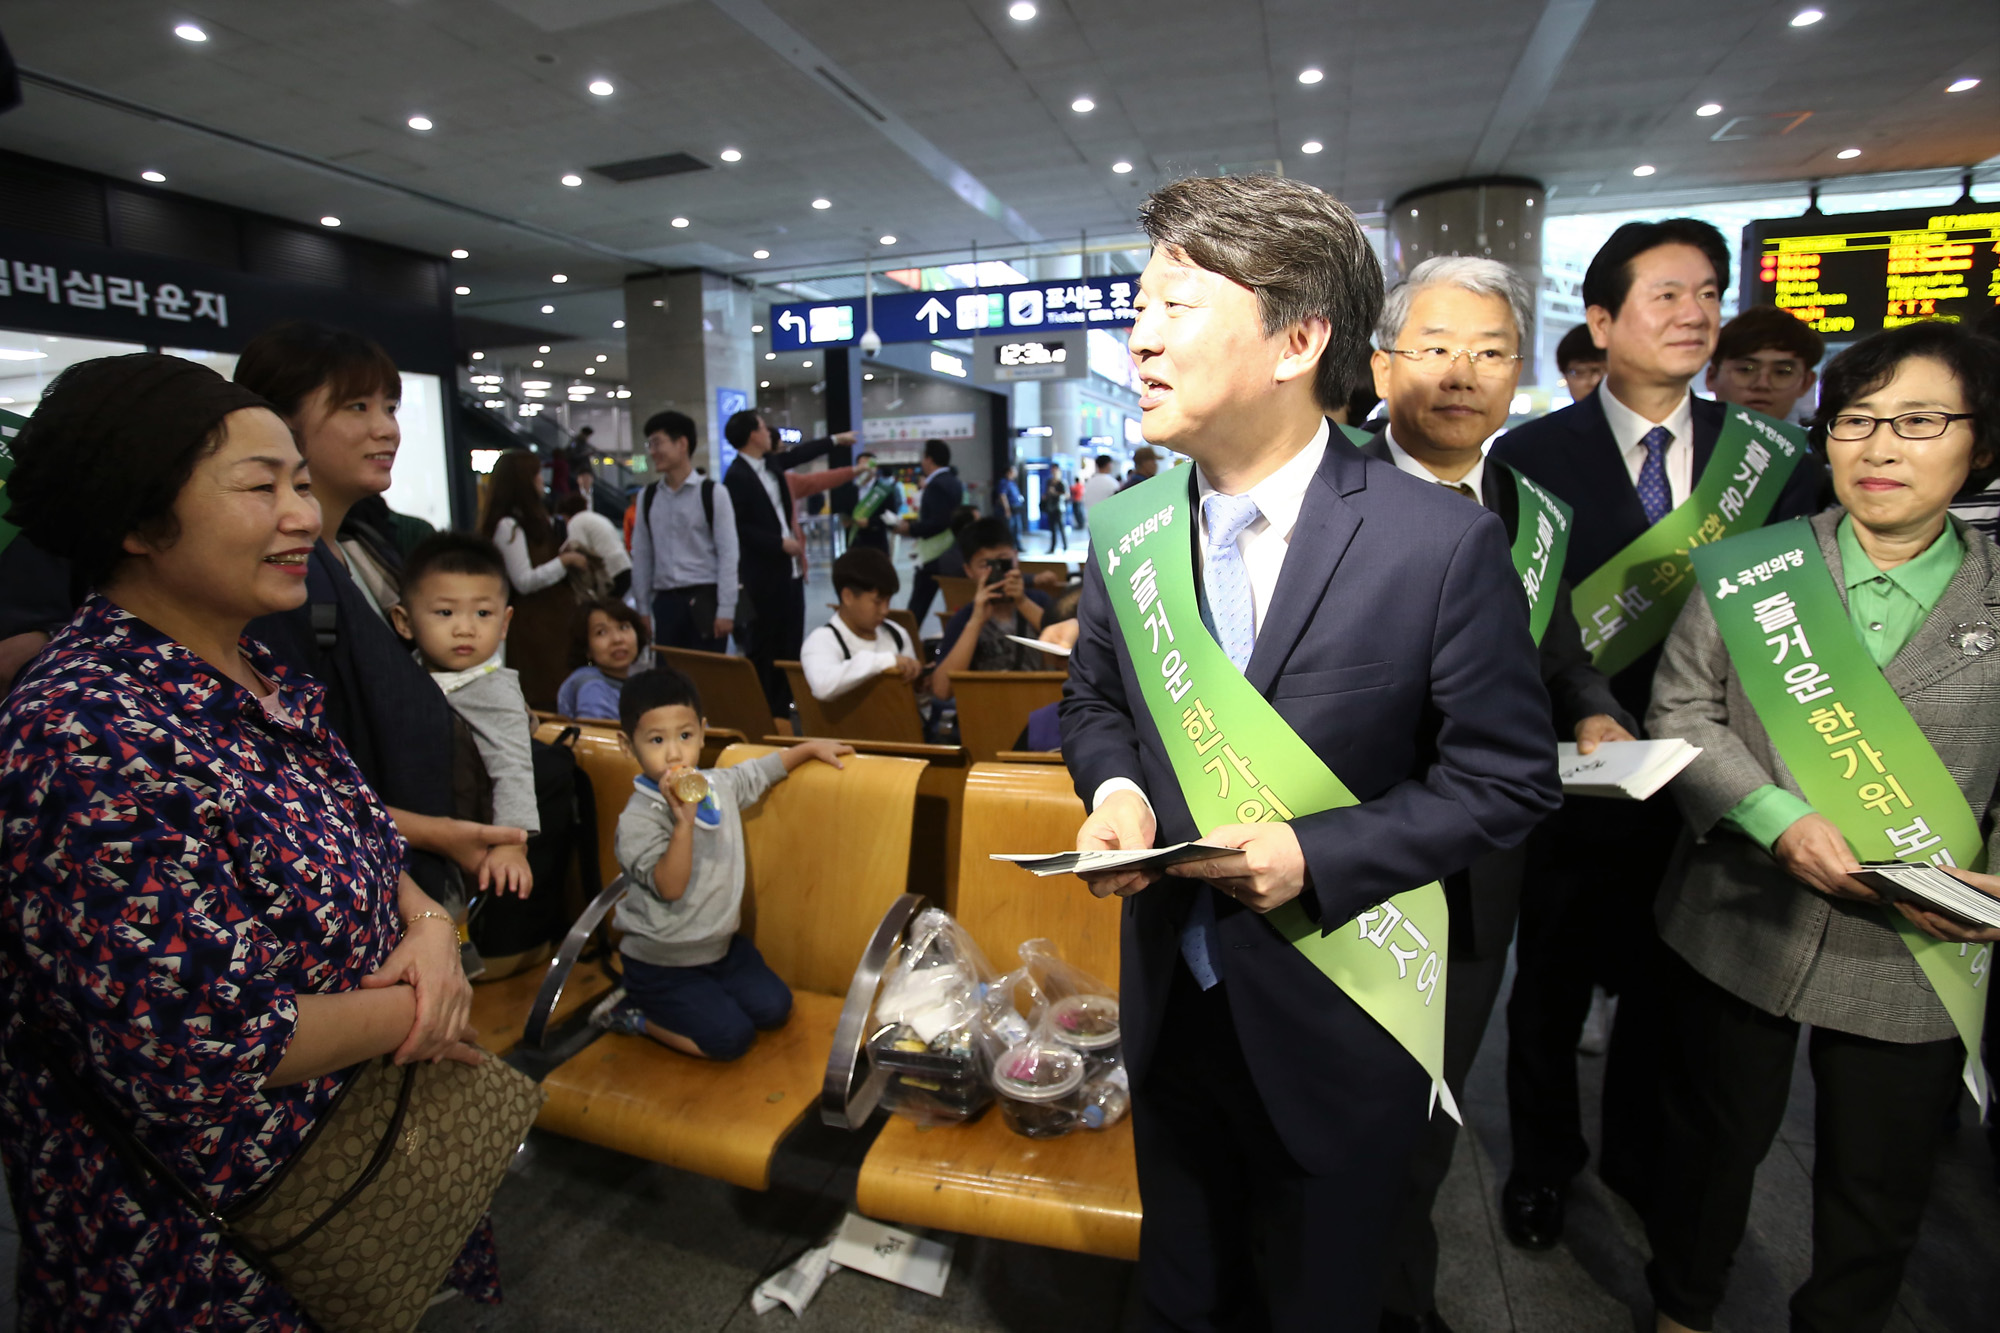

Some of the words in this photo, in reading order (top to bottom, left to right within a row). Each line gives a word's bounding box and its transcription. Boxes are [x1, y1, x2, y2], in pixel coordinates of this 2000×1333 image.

[0, 258, 229, 328] 버십라운지
[1110, 282, 1131, 308] 곳
[1887, 299, 1936, 316] KTX
[1718, 439, 1771, 522] 즐거운
[1118, 504, 1175, 555] 국민의당
[1737, 548, 1805, 587] 국민의당
[1129, 557, 1194, 704] 즐거운
[1752, 591, 1835, 704] 즐거운
[1807, 701, 1914, 816] 한가위
